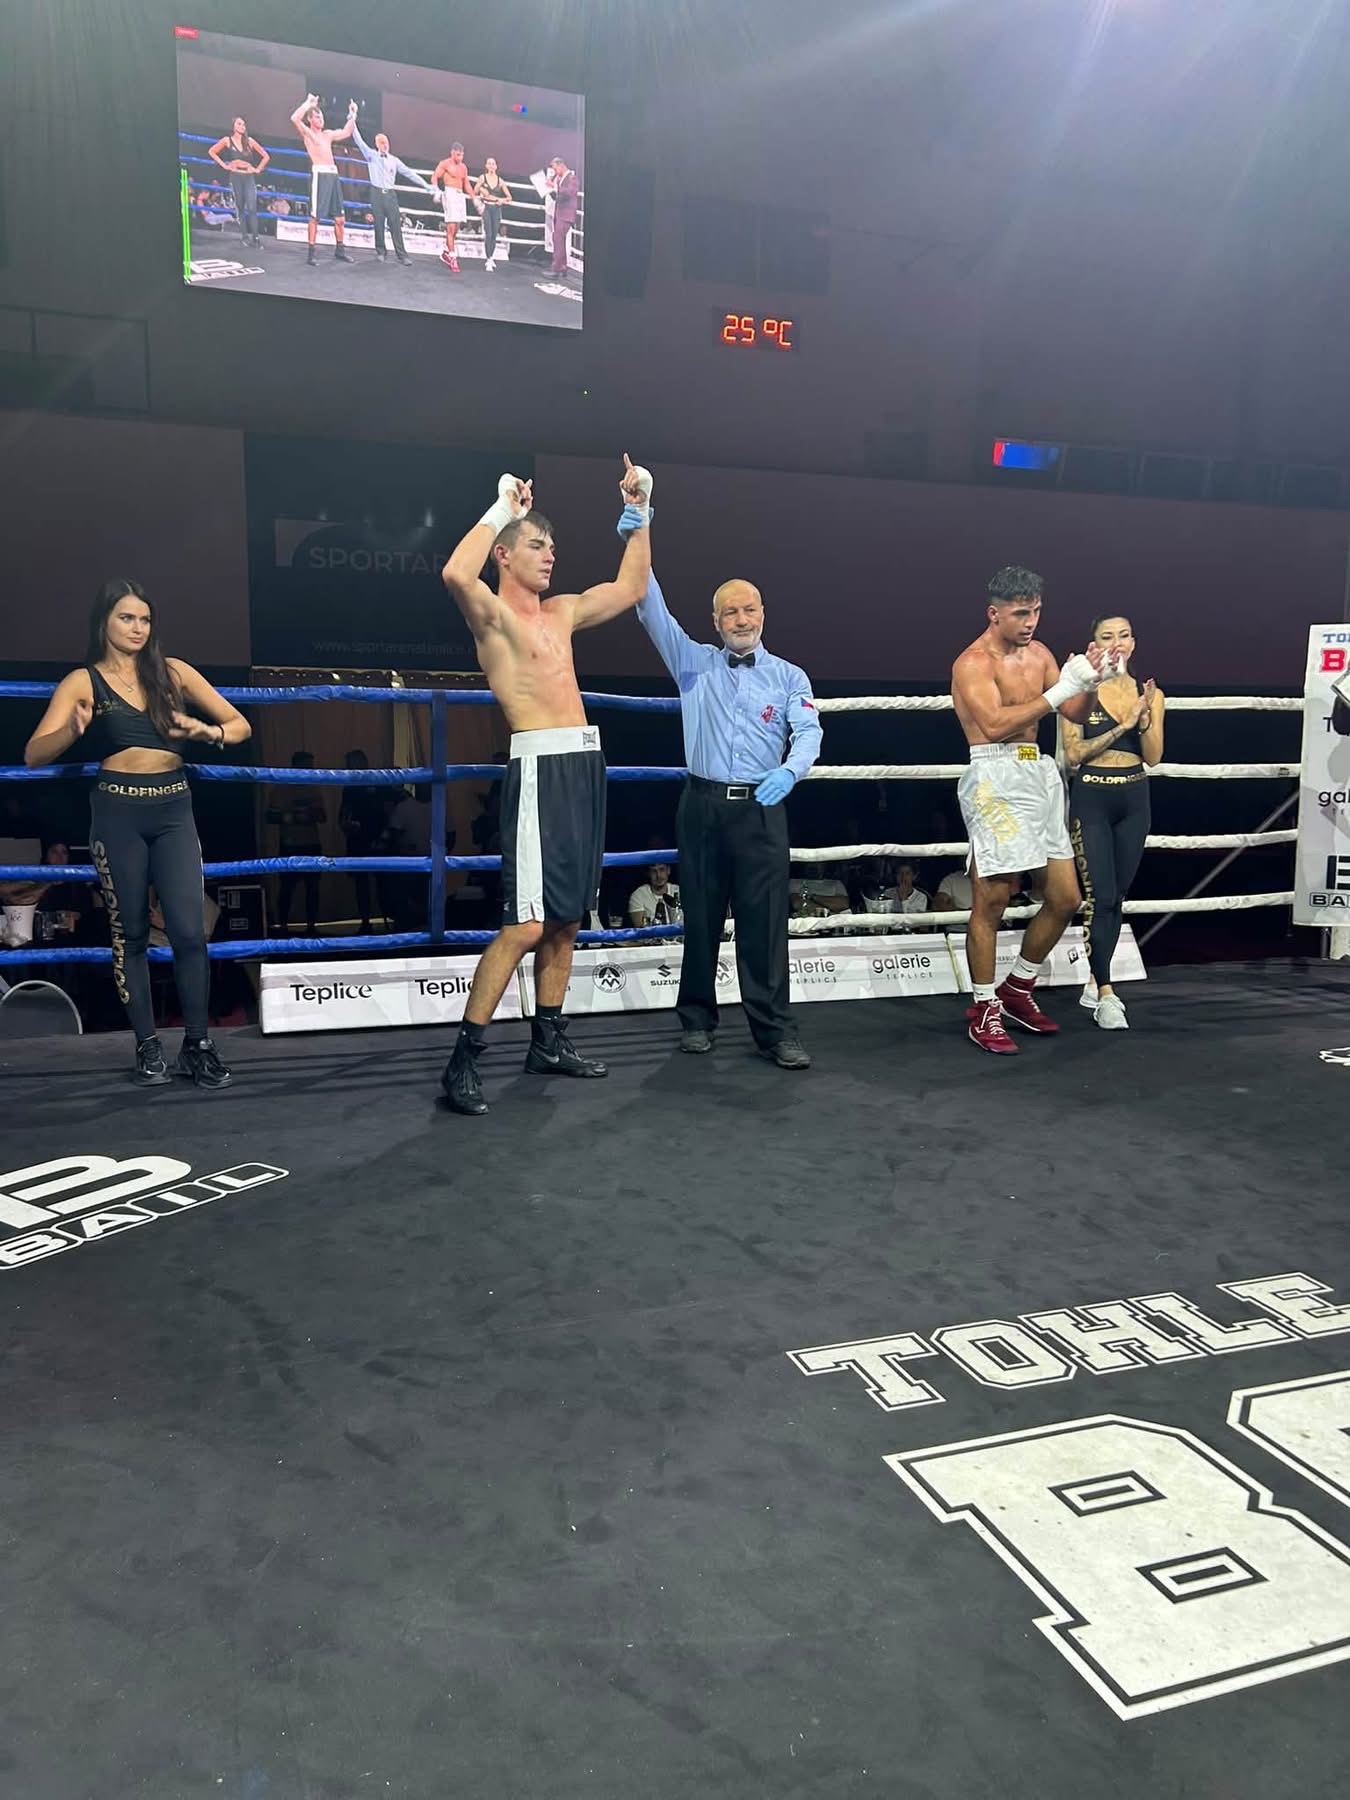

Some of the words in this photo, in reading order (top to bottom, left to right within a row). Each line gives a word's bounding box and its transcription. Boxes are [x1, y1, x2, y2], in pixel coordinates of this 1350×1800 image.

[724, 314, 754, 342] 25
[308, 546, 447, 575] SPORTAR
[1322, 633, 1350, 643] TO
[789, 957, 836, 974] alerie
[872, 953, 931, 974] galerie
[650, 979, 681, 987] SUZUK
[886, 971, 934, 981] TEPLICE
[290, 982, 373, 1004] Teplice
[415, 977, 473, 998] Tepli
[786, 1271, 1350, 1412] TOHLE
